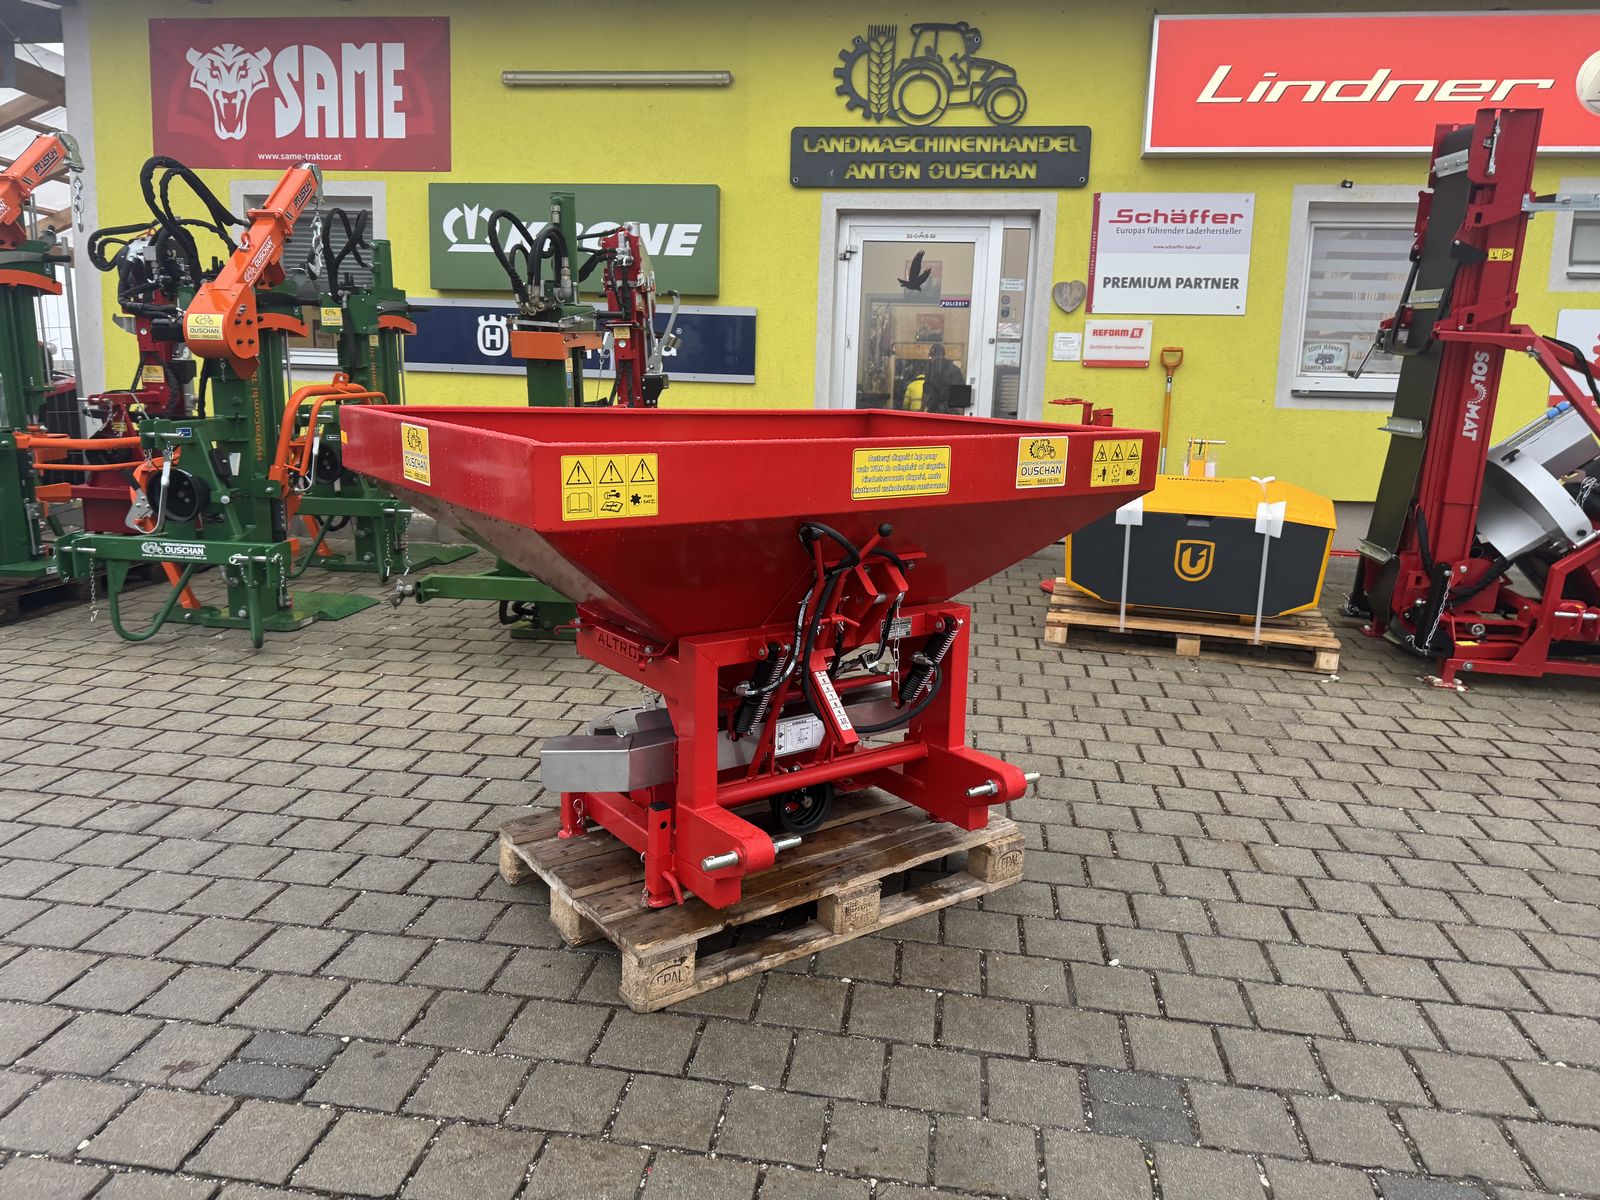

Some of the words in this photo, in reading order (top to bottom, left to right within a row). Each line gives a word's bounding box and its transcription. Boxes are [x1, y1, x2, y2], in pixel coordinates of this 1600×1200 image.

[273, 43, 406, 138] SAME
[1196, 65, 1555, 103] Lindner
[803, 135, 1081, 153] LANDMASCHINENHANDEL
[258, 153, 342, 161] www.same-traktor.at
[845, 161, 921, 179] ANTON
[928, 162, 1037, 180] OUSCHAN
[1108, 208, 1244, 224] Schäffer
[1116, 227, 1145, 236] Europas
[1147, 226, 1185, 235] führender
[1186, 227, 1242, 235] Laderhersteller
[1103, 276, 1172, 289] PREMIUM
[1175, 277, 1239, 290] PARTNER
[190, 327, 219, 335] OUSCHAN
[1092, 328, 1129, 337] REFORM
[252, 387, 263, 461] HydroCombi
[1021, 466, 1061, 476] OUSCHAN
[165, 547, 204, 555] OUSCHAN
